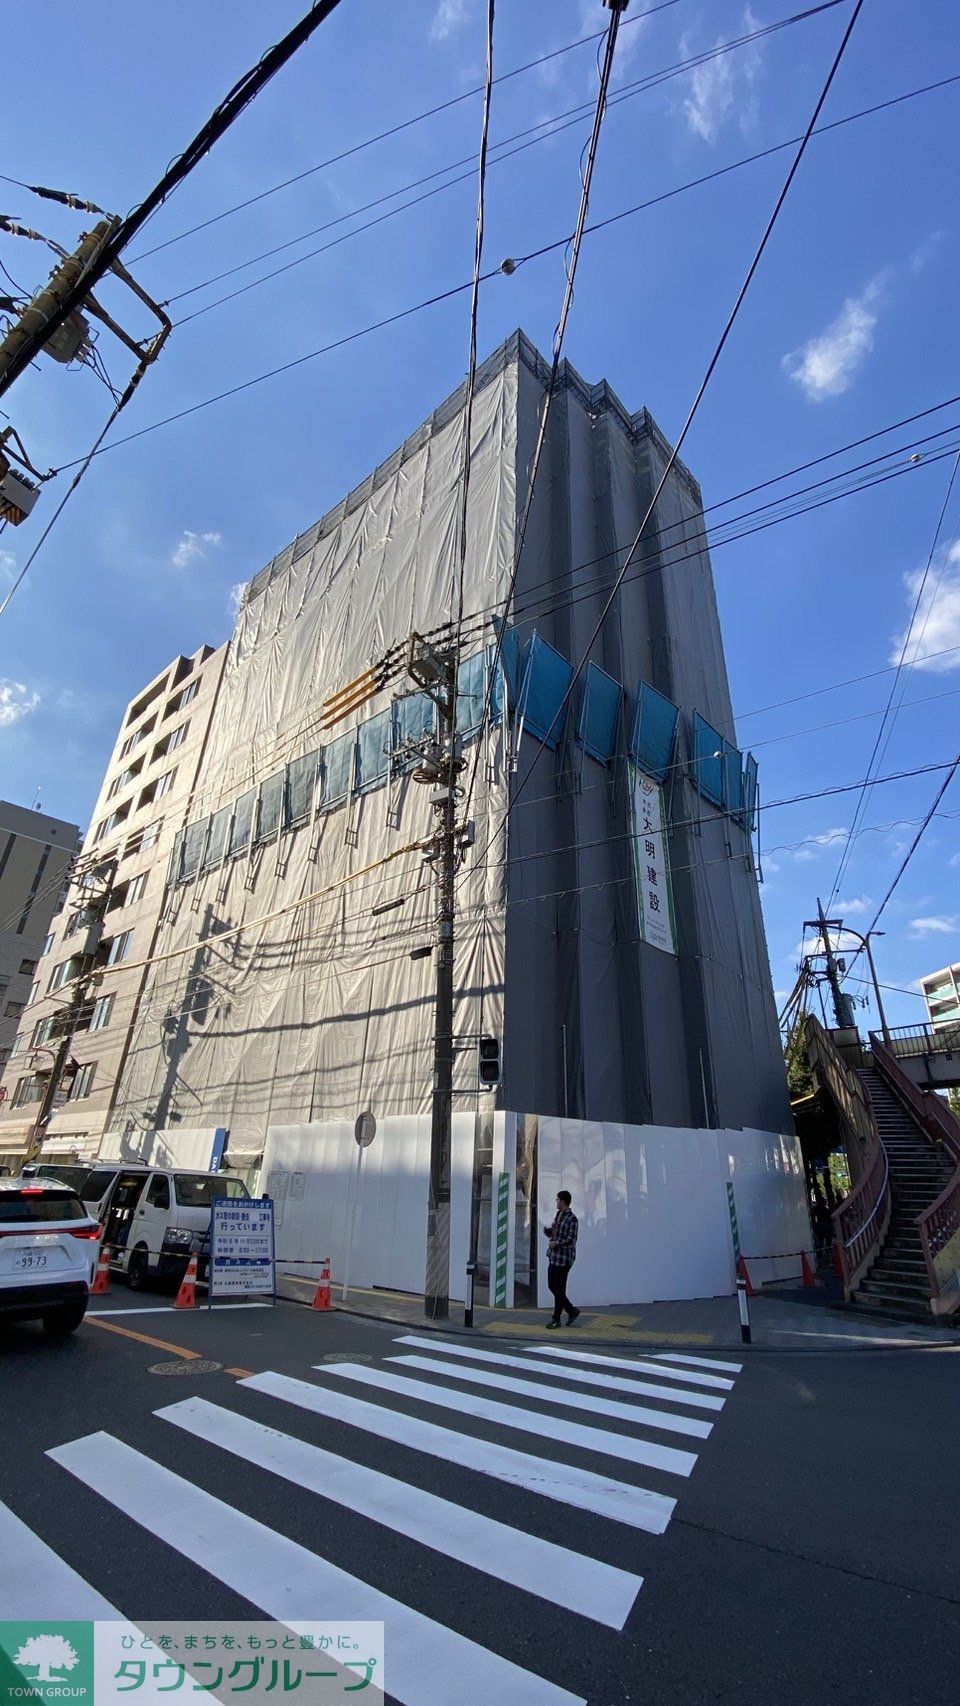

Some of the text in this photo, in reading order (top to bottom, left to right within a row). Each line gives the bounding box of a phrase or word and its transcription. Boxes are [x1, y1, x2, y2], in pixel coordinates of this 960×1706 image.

[643, 817, 660, 913] 大明建設
[221, 1222, 265, 1231] 行っています
